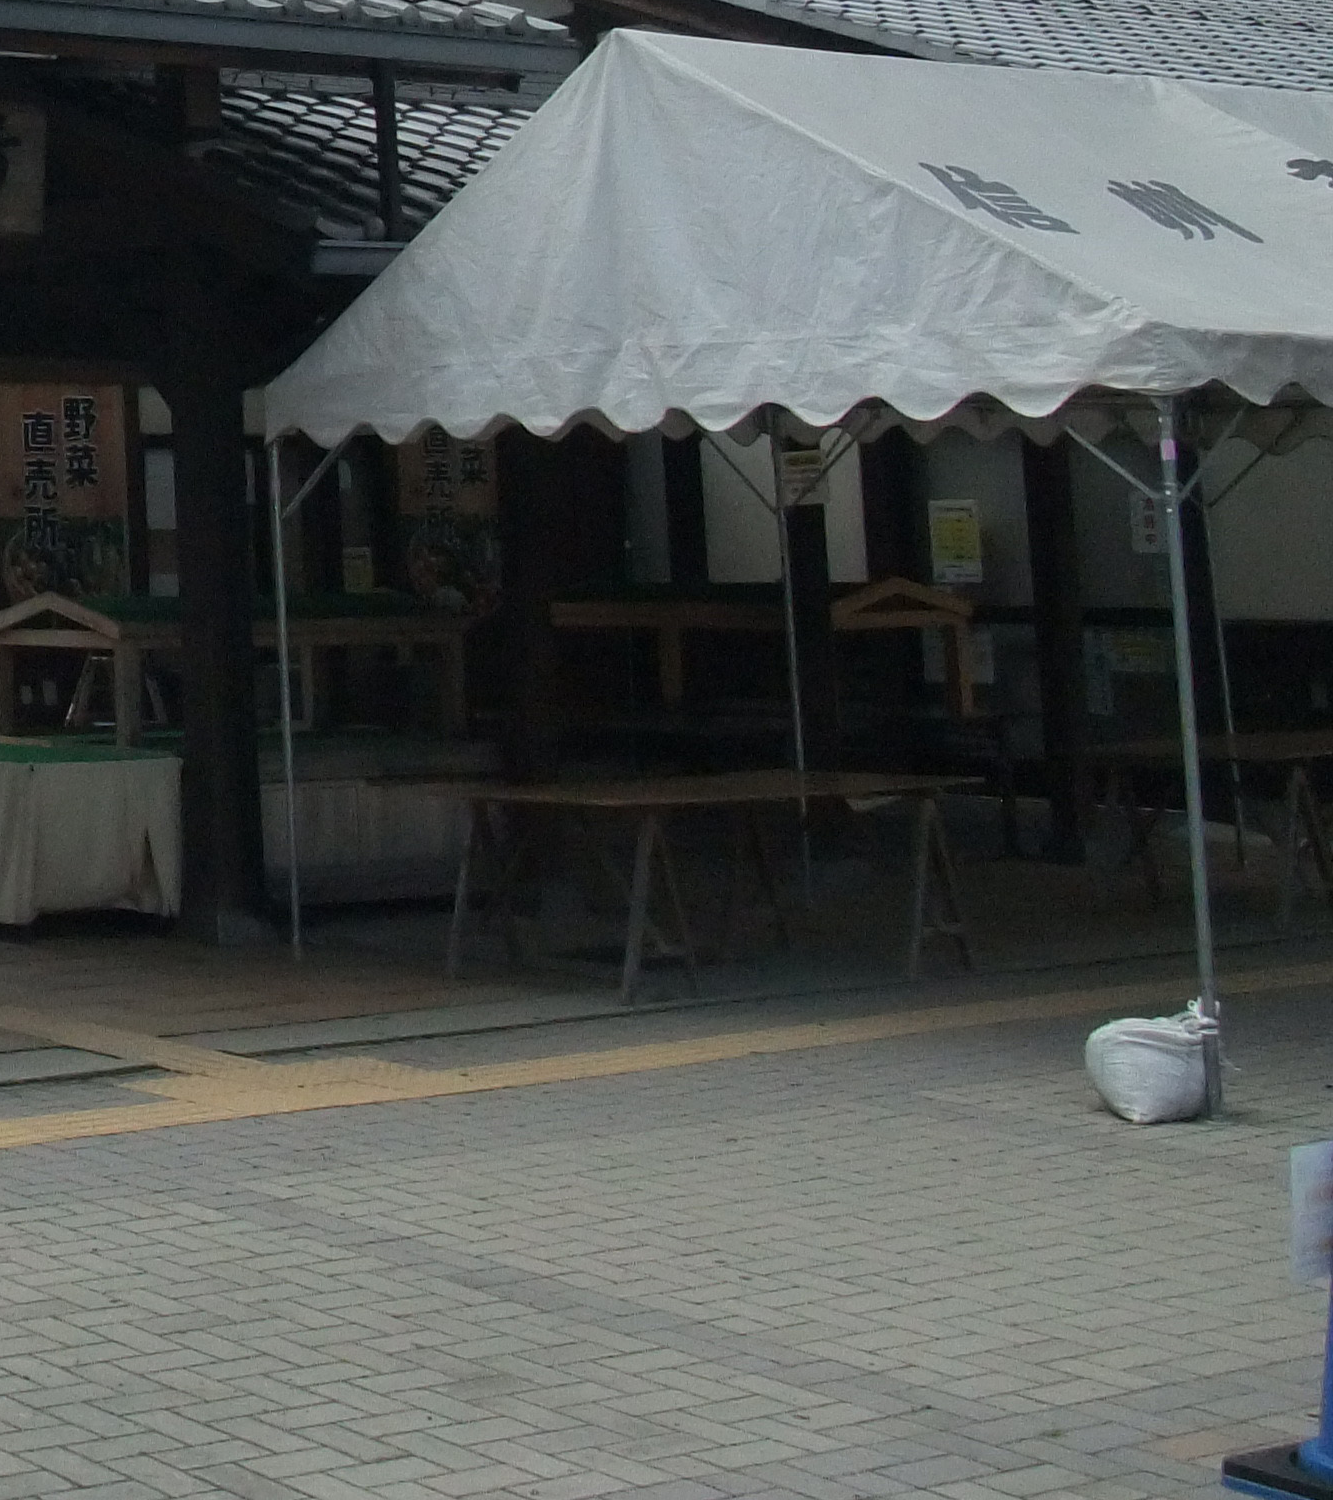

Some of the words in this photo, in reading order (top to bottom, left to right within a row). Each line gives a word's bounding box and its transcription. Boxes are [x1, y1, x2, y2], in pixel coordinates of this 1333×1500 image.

[22, 411, 59, 549] 直売所
[62, 396, 98, 487] 野菜
